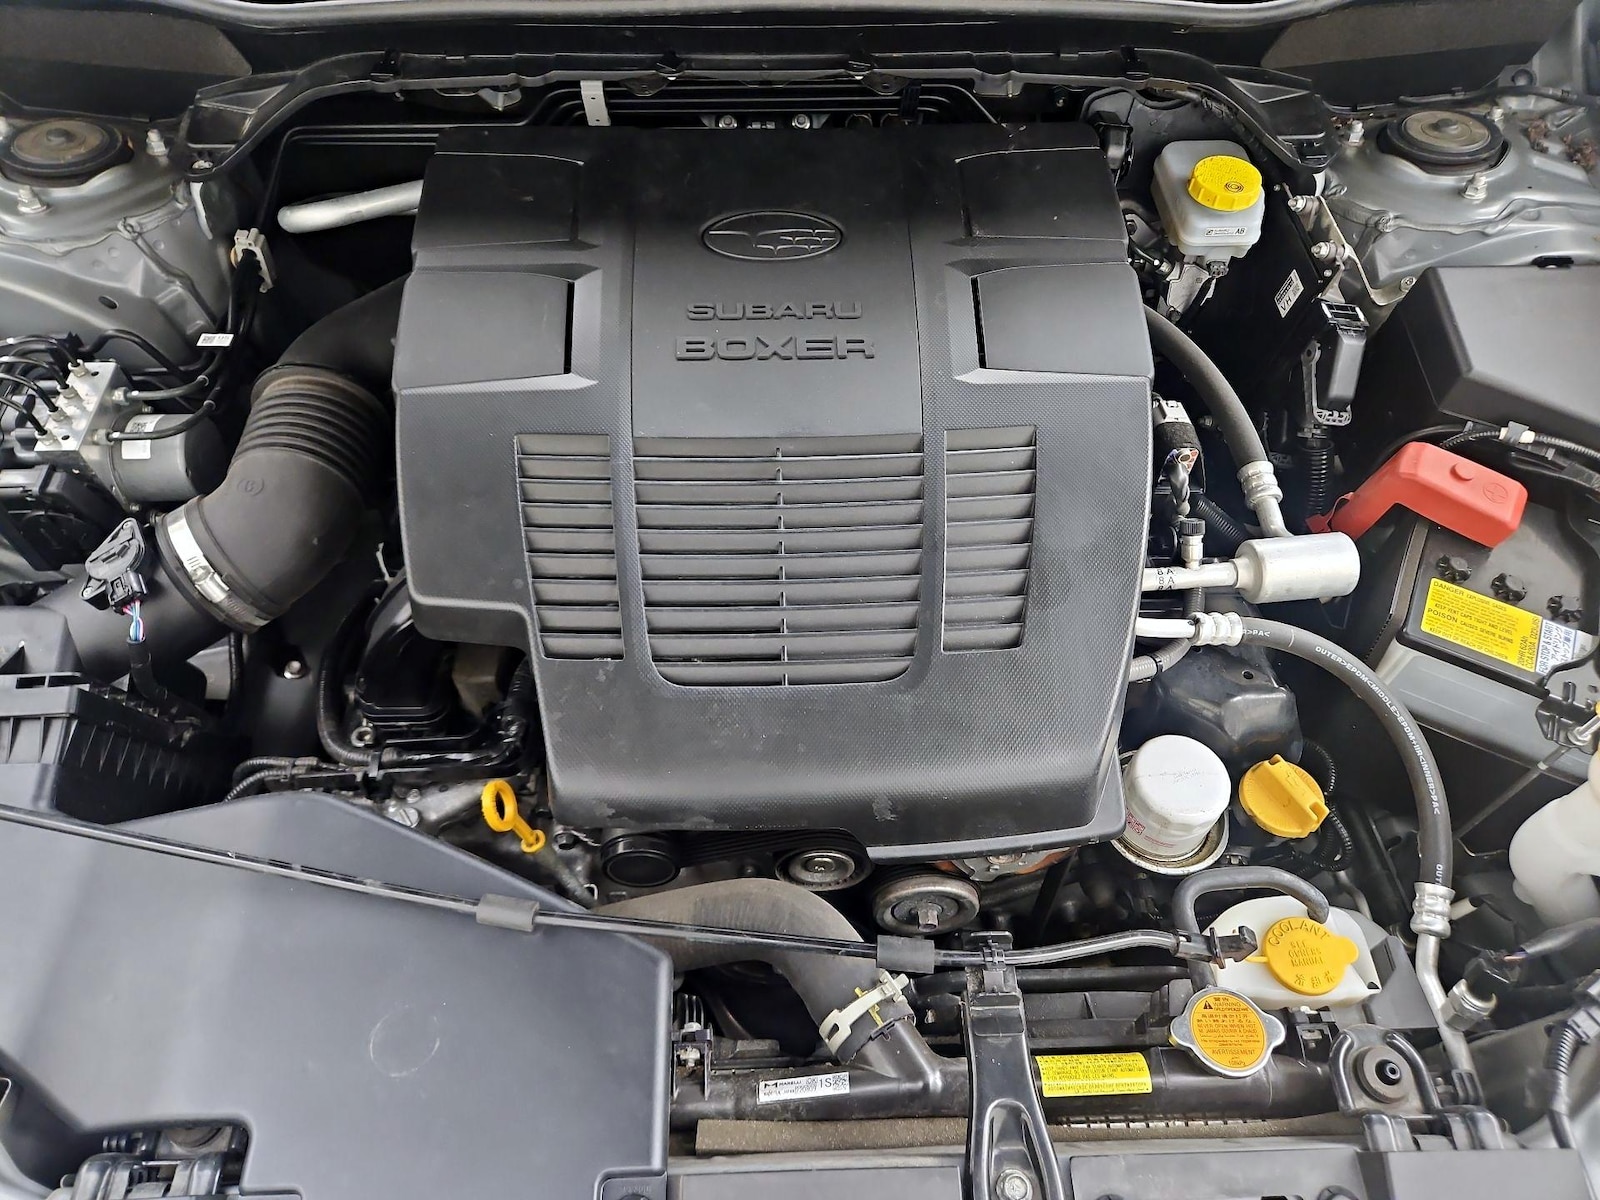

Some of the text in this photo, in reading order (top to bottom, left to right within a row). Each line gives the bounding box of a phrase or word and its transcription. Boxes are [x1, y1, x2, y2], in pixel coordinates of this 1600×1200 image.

[687, 302, 862, 320] SUBARU
[676, 336, 875, 360] BOXER
[1433, 581, 1464, 596] DANGER
[1427, 607, 1457, 622] POISON
[1543, 622, 1554, 640] START
[1540, 644, 1550, 660] STOP
[1539, 660, 1548, 673] FOR
[1268, 920, 1331, 946] COOLANT
